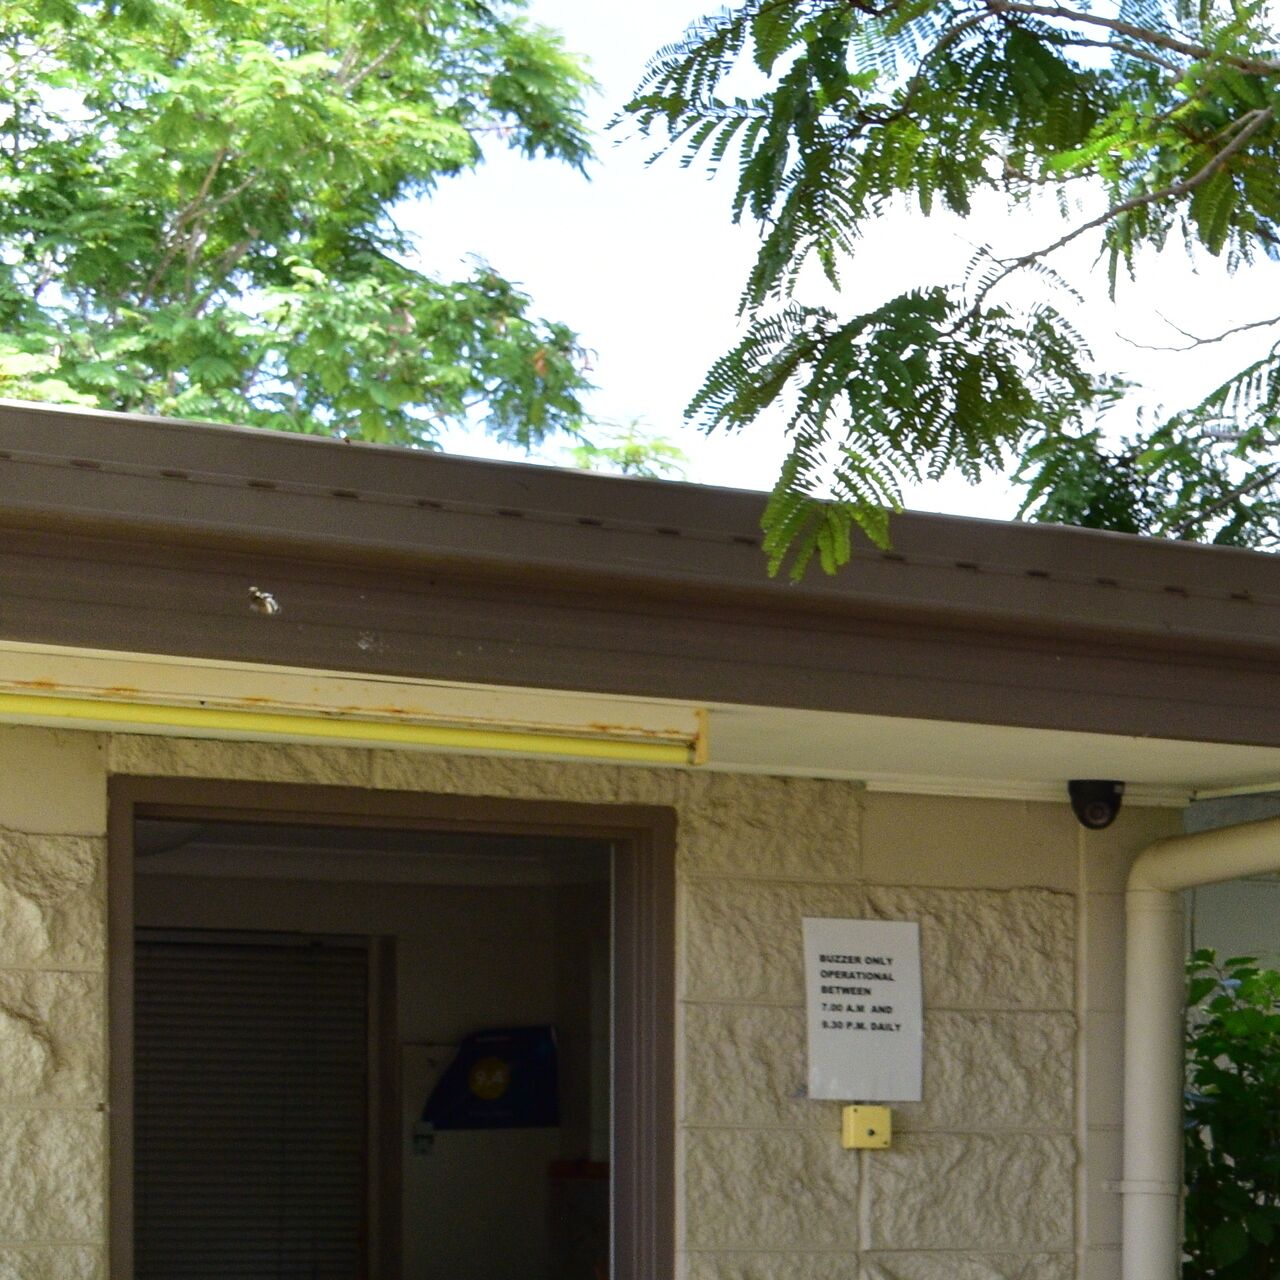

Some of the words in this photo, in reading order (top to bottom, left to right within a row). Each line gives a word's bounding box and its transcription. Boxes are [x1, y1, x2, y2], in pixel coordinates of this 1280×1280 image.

[819, 954, 862, 965] BUZZER
[865, 955, 894, 966] ONLY
[820, 969, 896, 982] OPERATIONAL
[821, 985, 871, 996] BETWEEN
[871, 1005, 893, 1015] AND
[870, 1022, 902, 1033] DAILY
